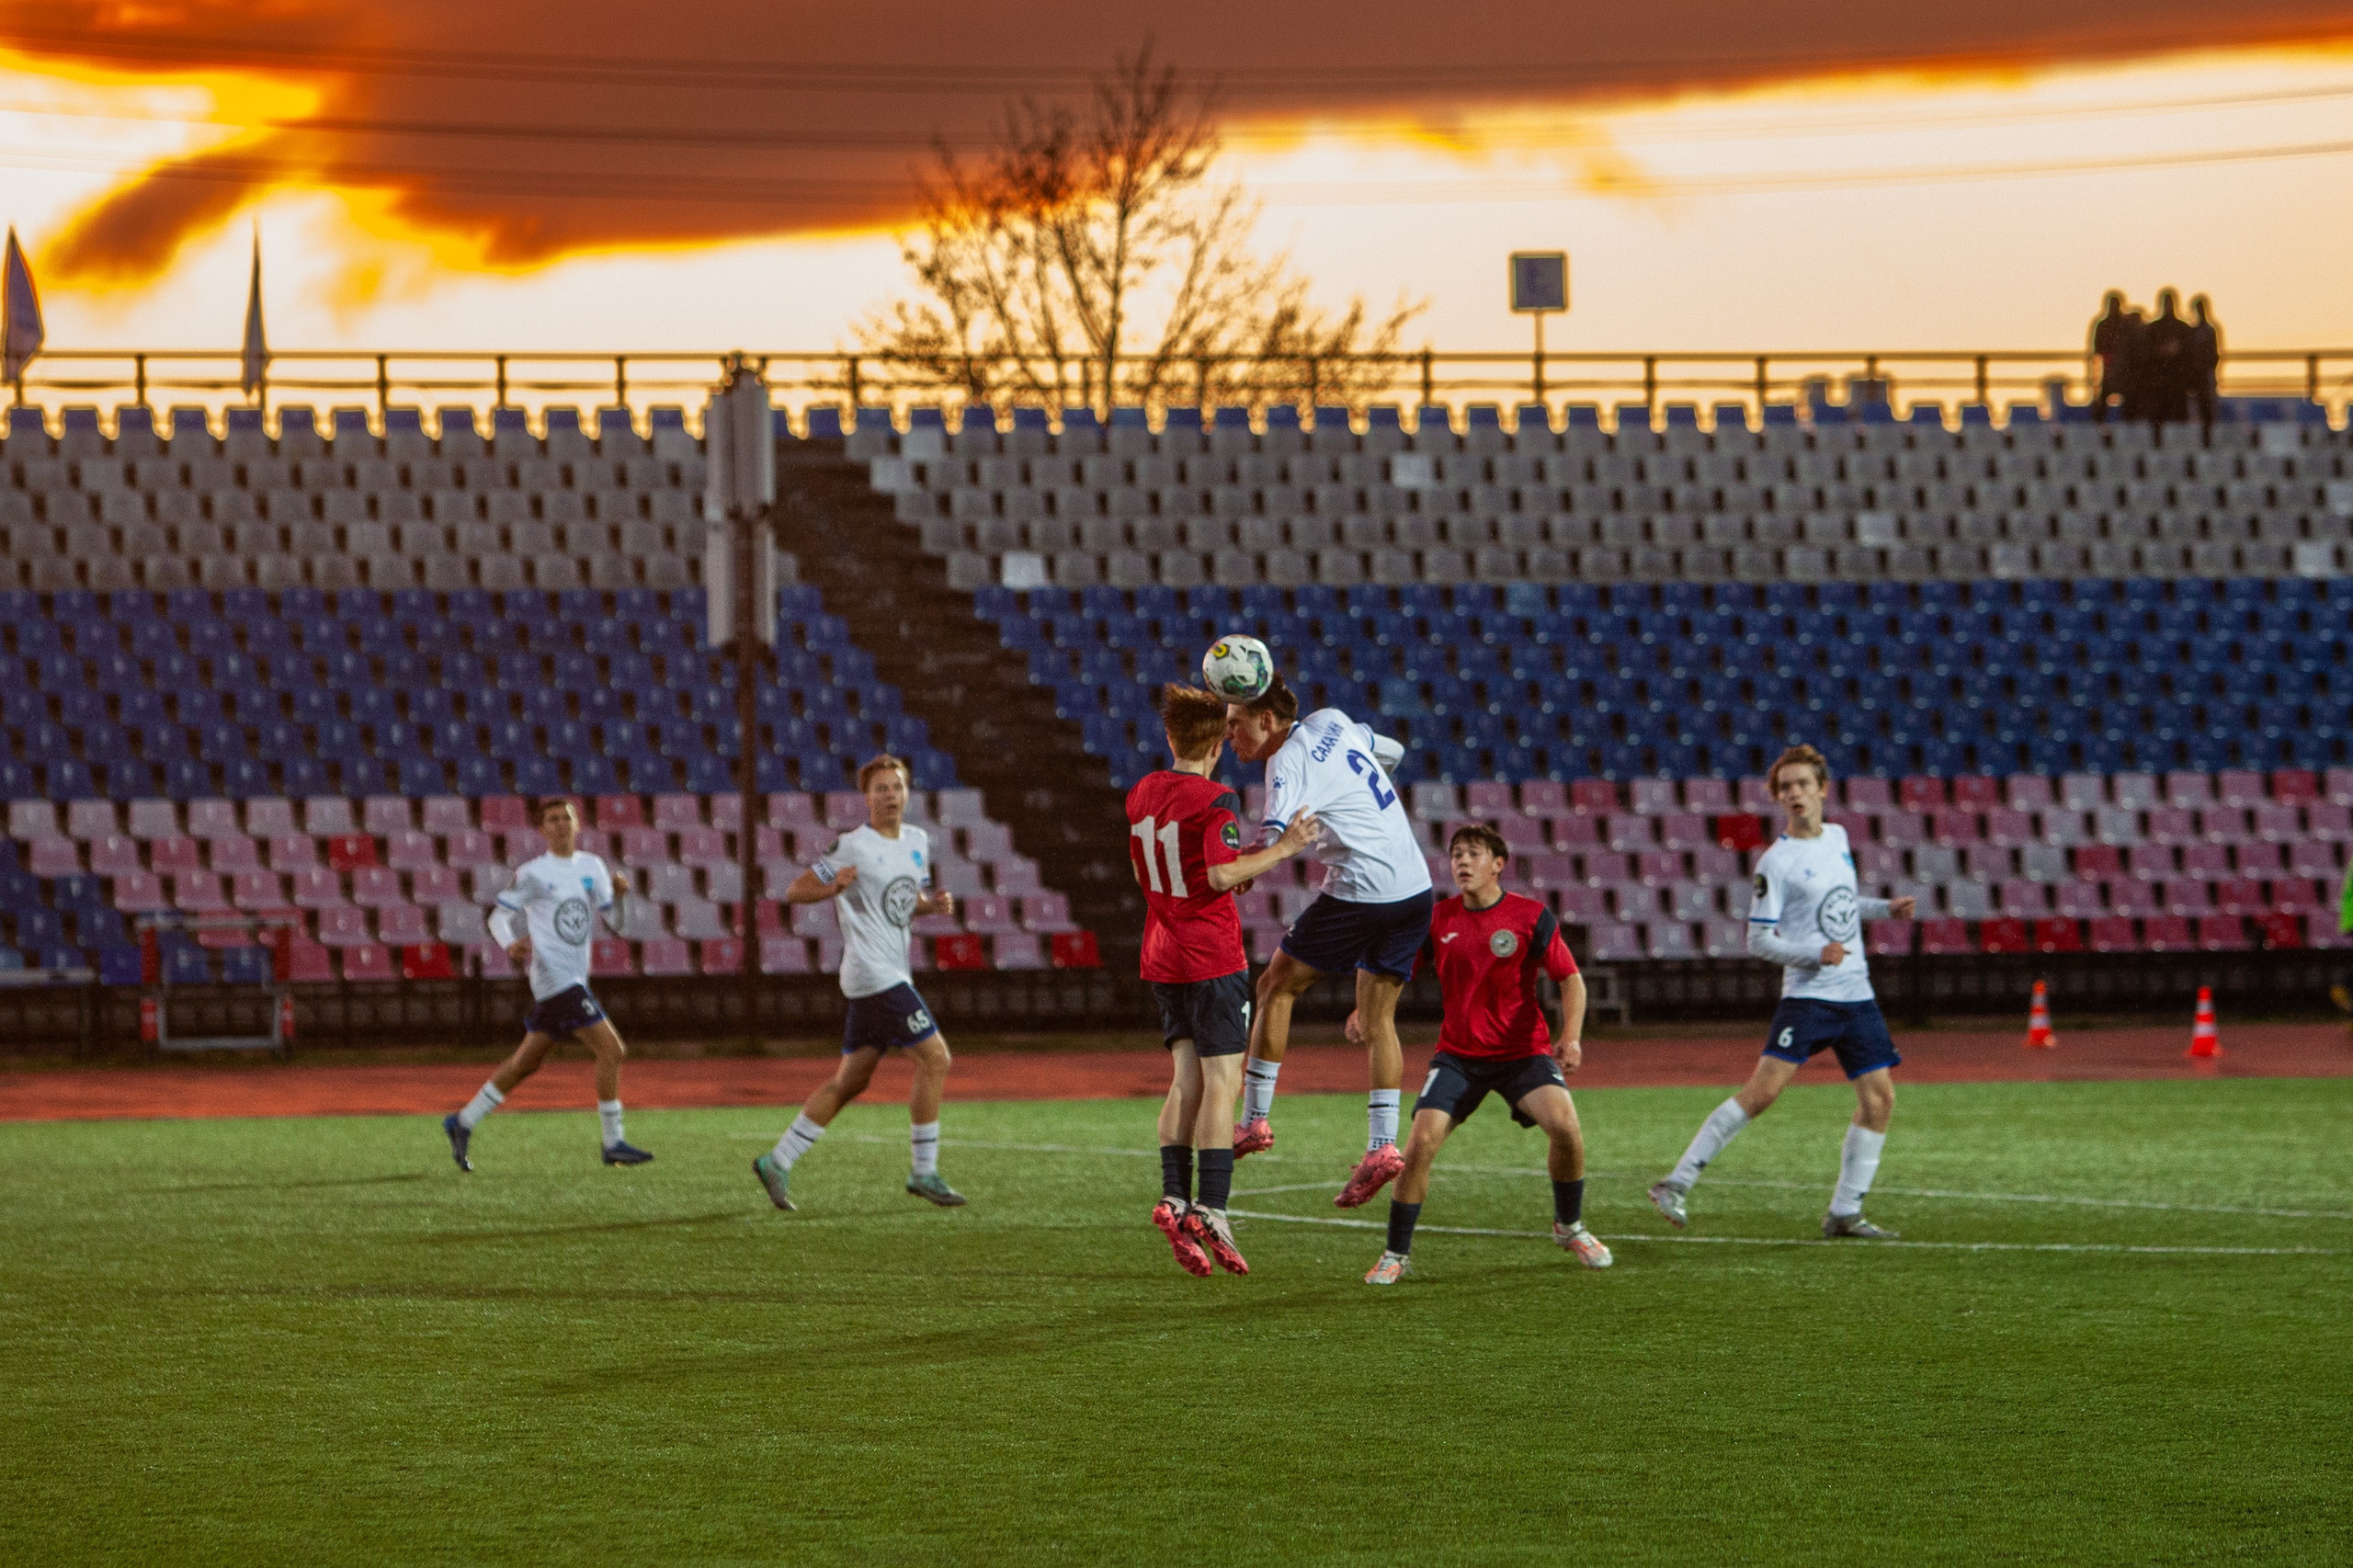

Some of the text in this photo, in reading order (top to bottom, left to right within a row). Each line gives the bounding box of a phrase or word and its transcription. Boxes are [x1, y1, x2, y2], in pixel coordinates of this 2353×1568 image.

[1347, 749, 1396, 811] 2
[1131, 814, 1188, 898] 11
[1778, 1027, 1795, 1048] 6
